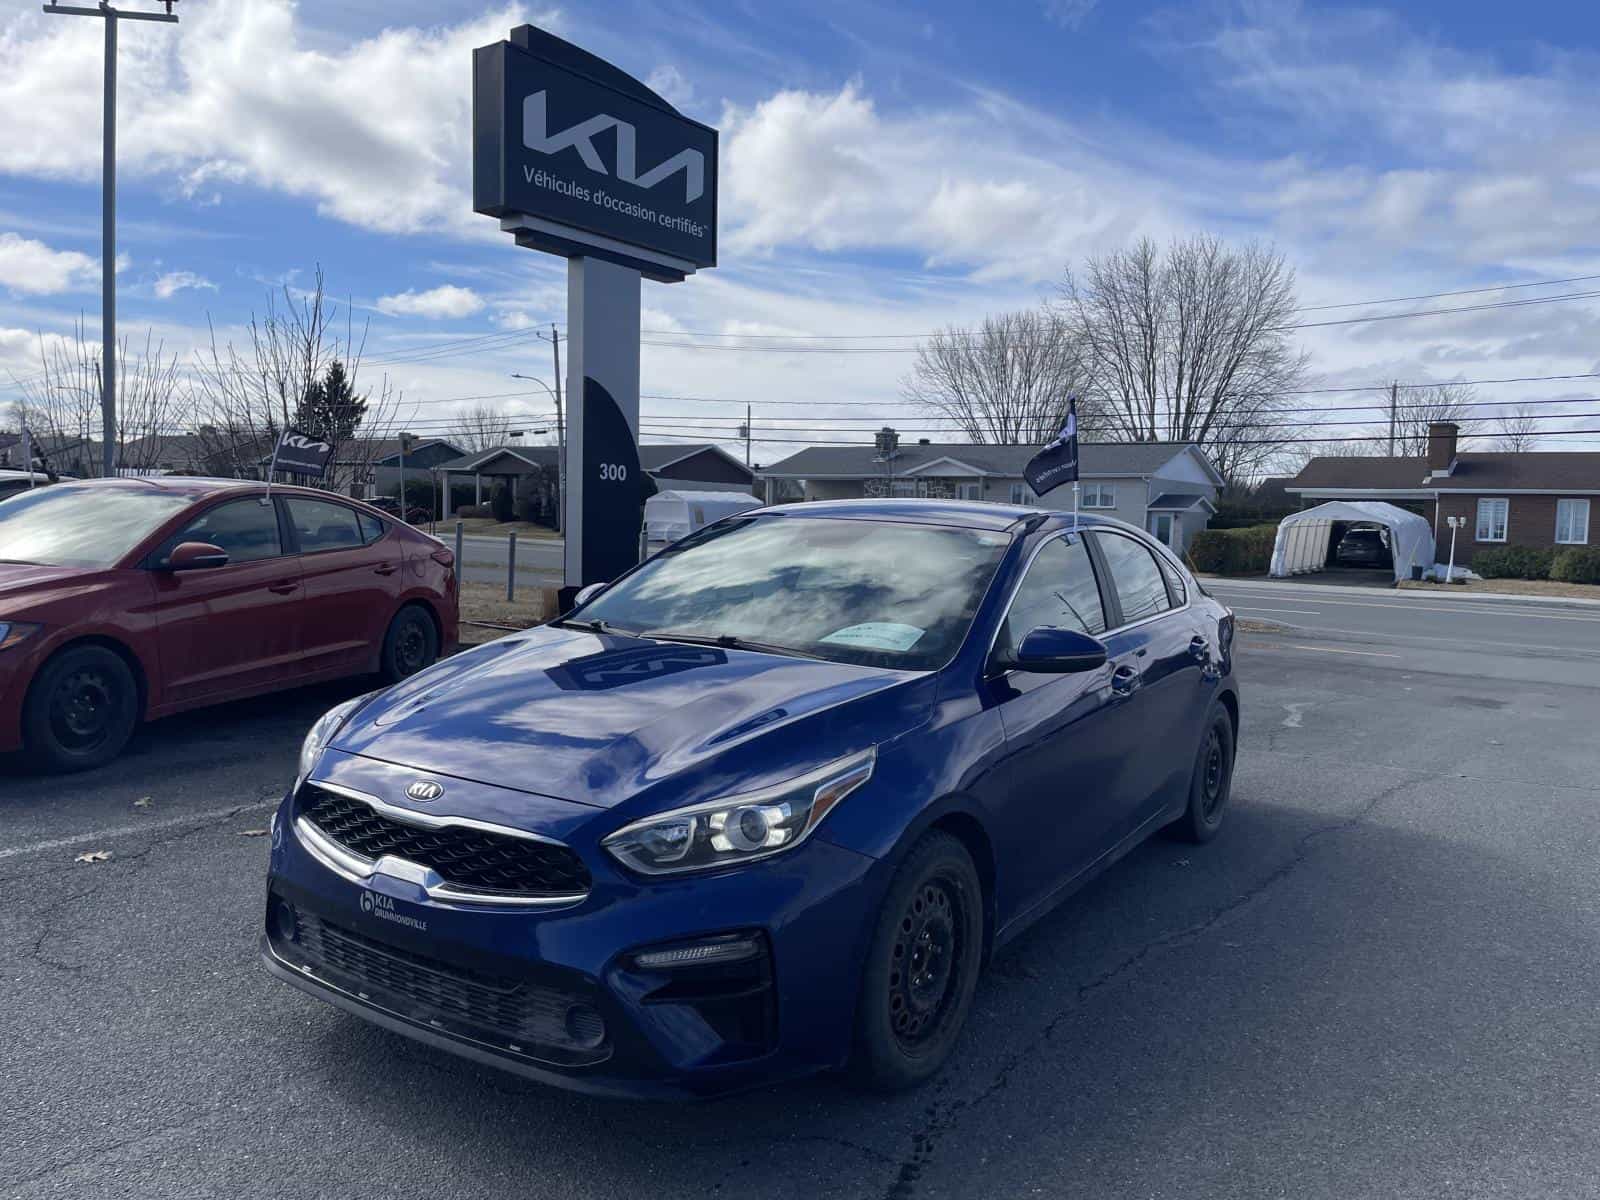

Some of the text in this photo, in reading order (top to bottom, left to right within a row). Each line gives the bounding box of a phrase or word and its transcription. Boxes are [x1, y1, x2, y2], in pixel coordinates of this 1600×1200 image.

[523, 164, 703, 238] Véhicules d'occasion certifiés
[599, 463, 627, 481] 300
[408, 782, 437, 798] KIA
[375, 893, 395, 911] KIA
